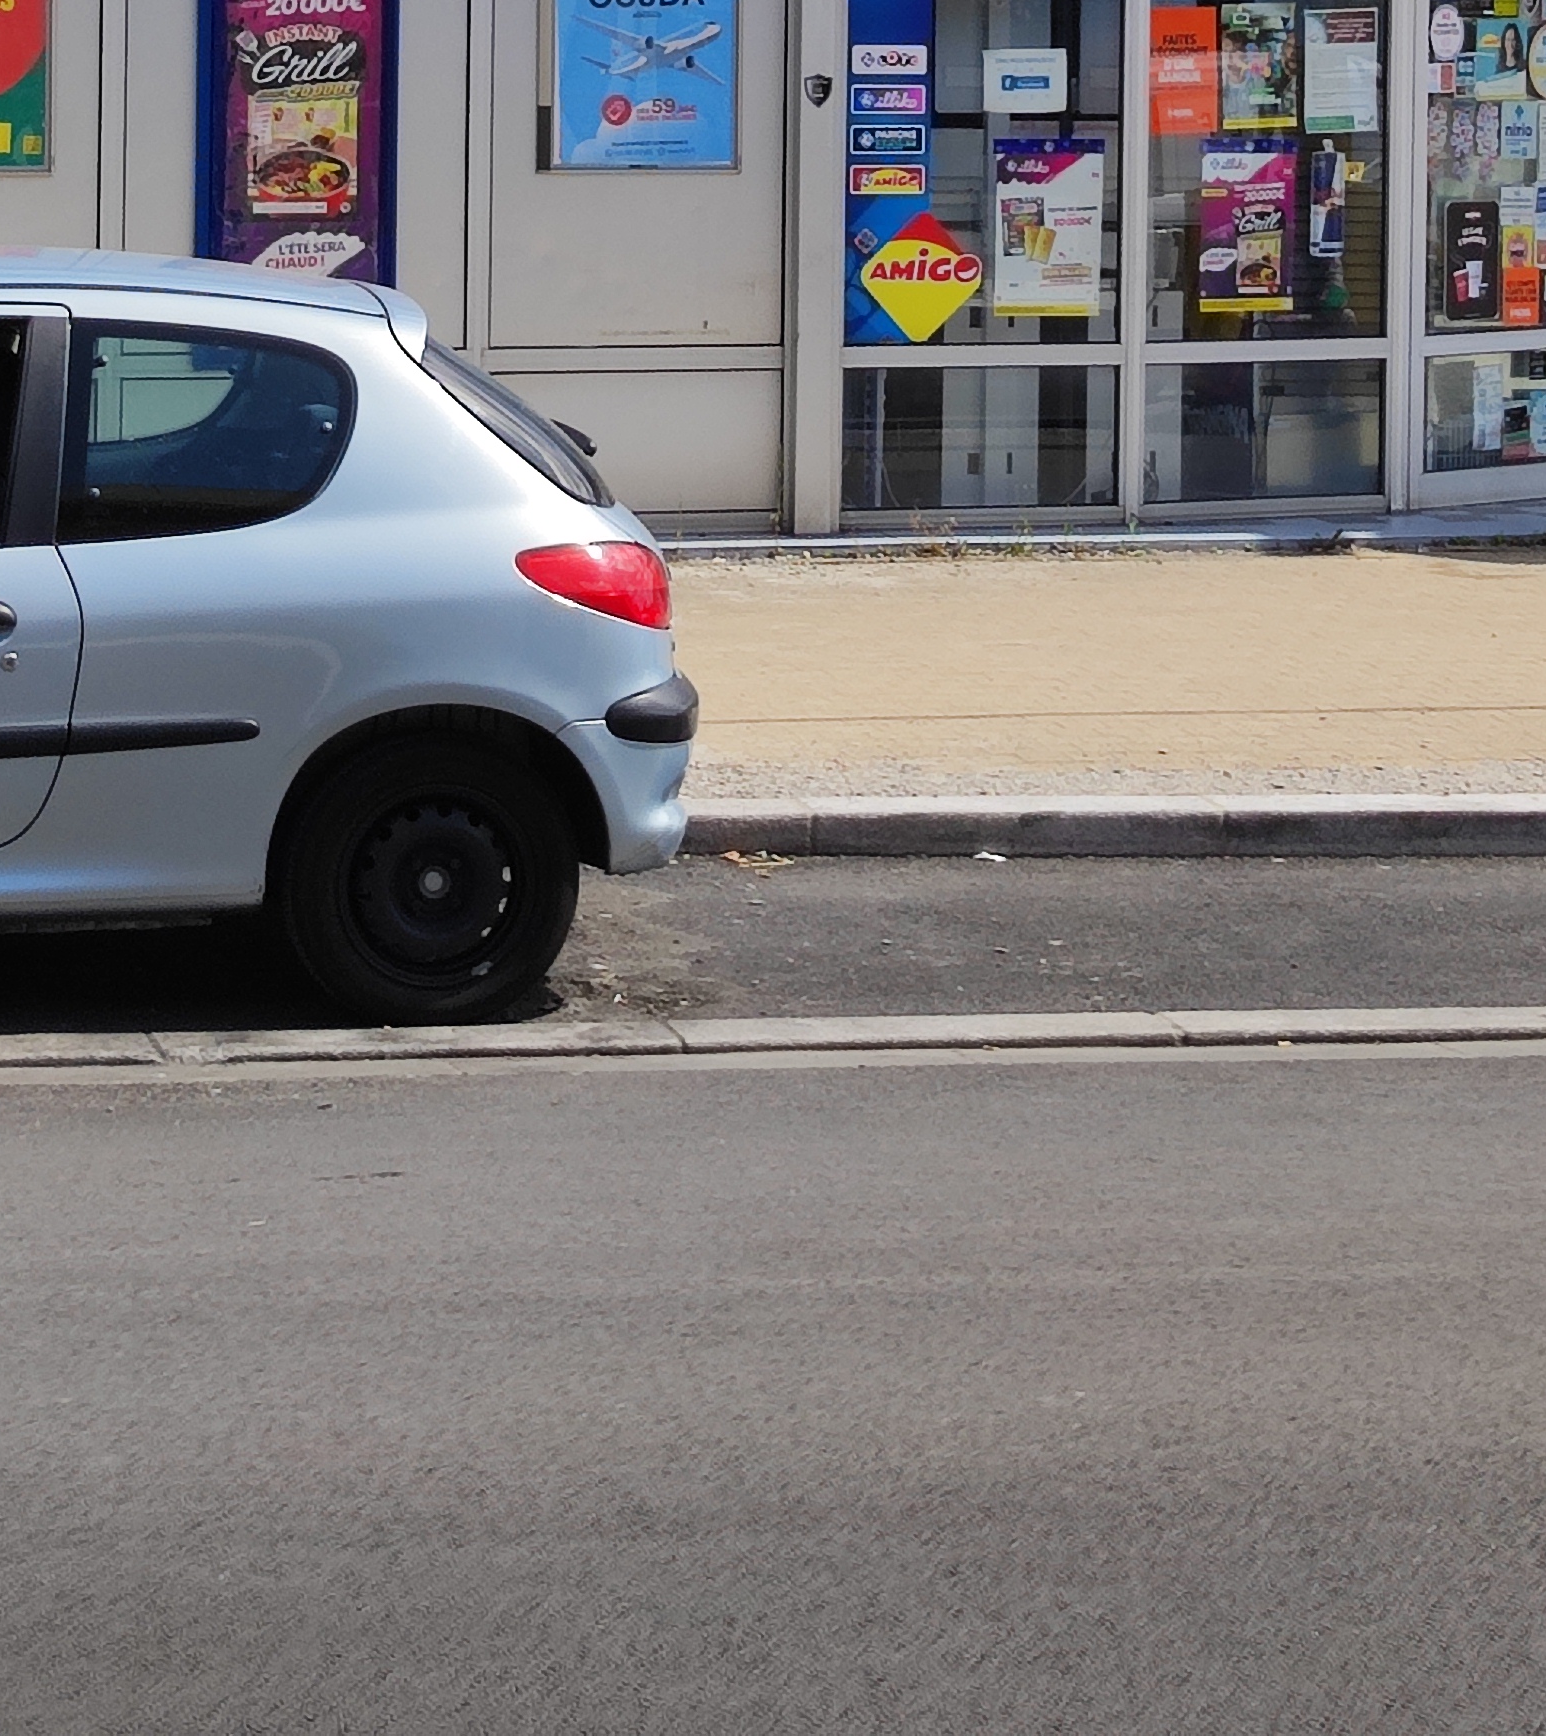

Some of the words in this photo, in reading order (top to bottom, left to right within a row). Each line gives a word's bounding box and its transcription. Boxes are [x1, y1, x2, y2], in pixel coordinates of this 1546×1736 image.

[264, 24, 343, 48] INSTANT
[251, 40, 358, 84] Grill
[651, 97, 676, 115] 59
[1238, 211, 1282, 233] Grill
[278, 241, 310, 256] L'ÉTÉ
[313, 240, 347, 254] SERA
[265, 256, 318, 270] CHAUD
